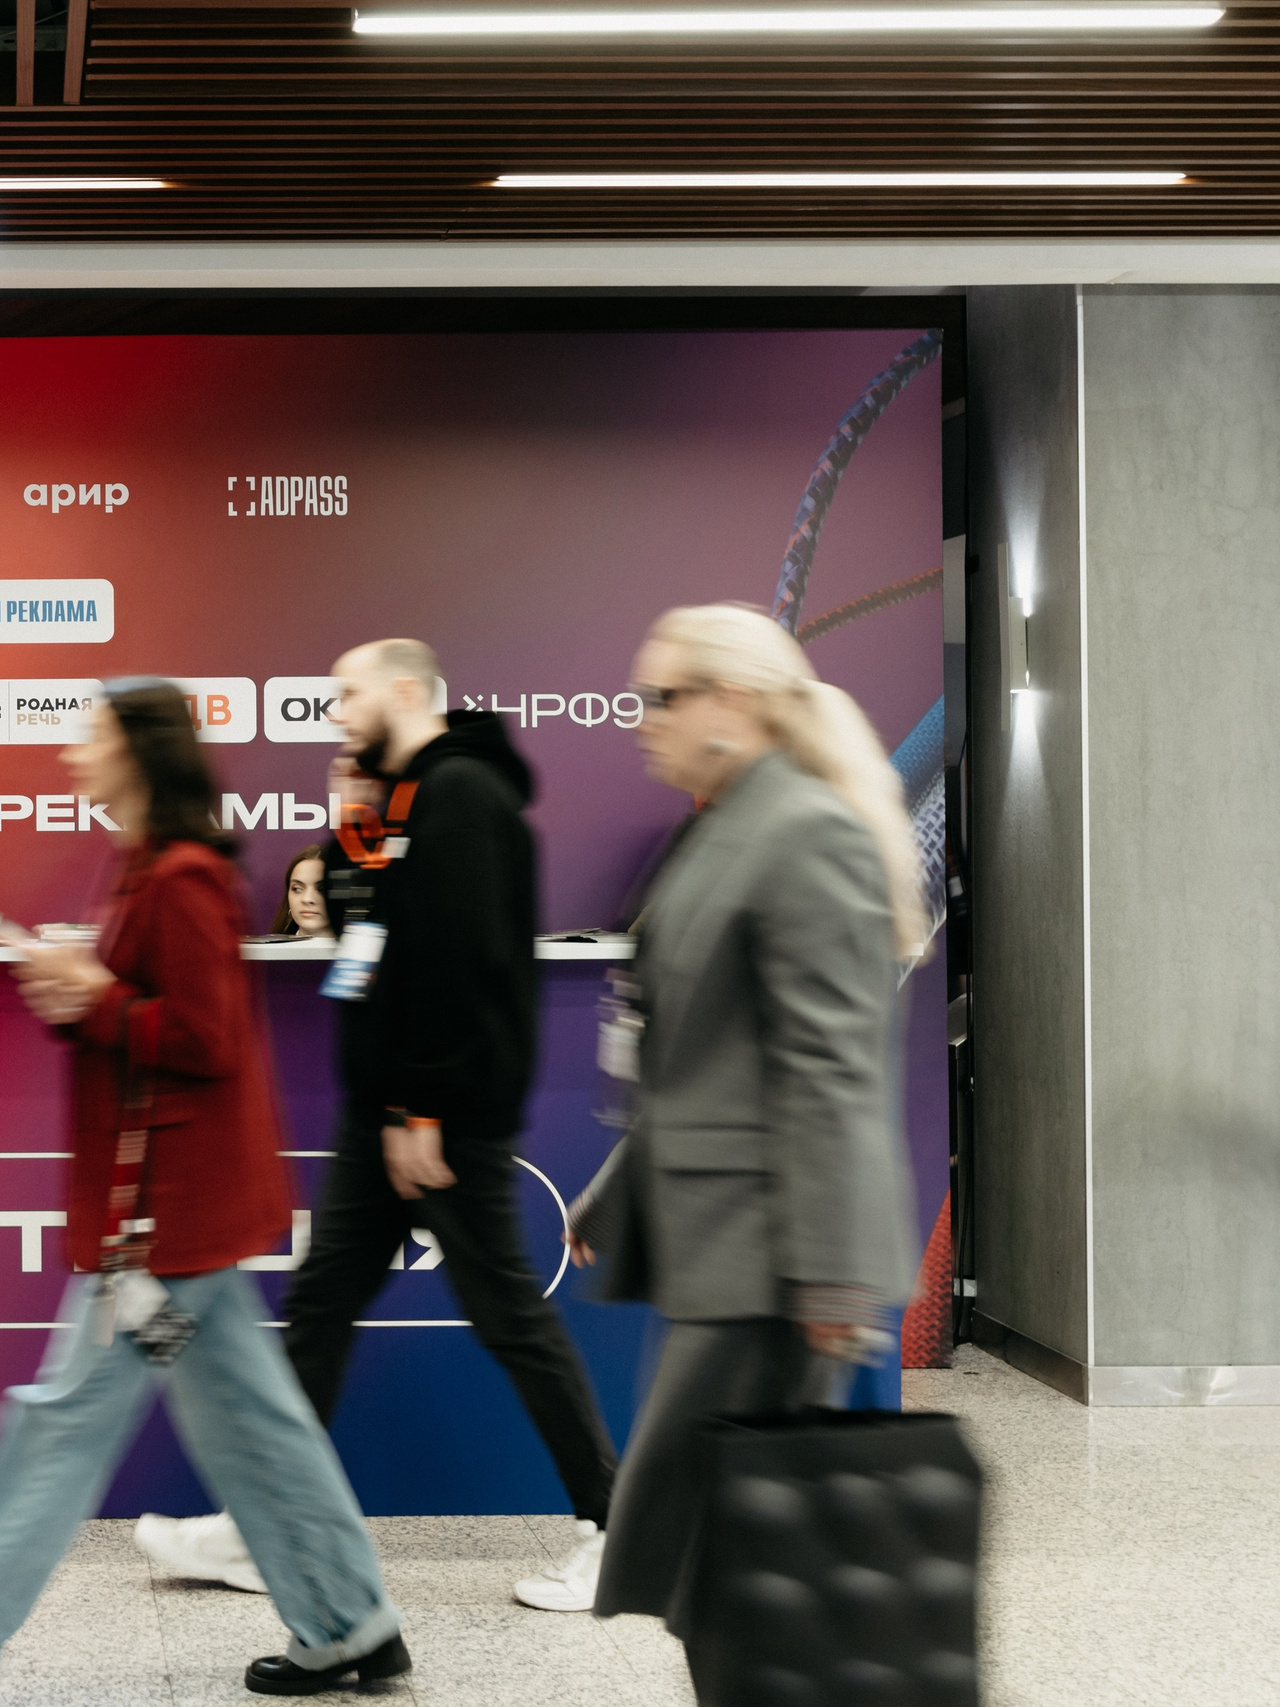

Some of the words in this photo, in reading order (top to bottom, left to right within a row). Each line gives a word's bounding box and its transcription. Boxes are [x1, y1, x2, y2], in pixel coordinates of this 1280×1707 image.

[23, 483, 130, 513] арир
[260, 475, 348, 516] ADPASS
[6, 600, 98, 623] РЕКЛАМА
[16, 698, 93, 712] РОДНАЯ
[16, 713, 62, 726] РЕЧЬ
